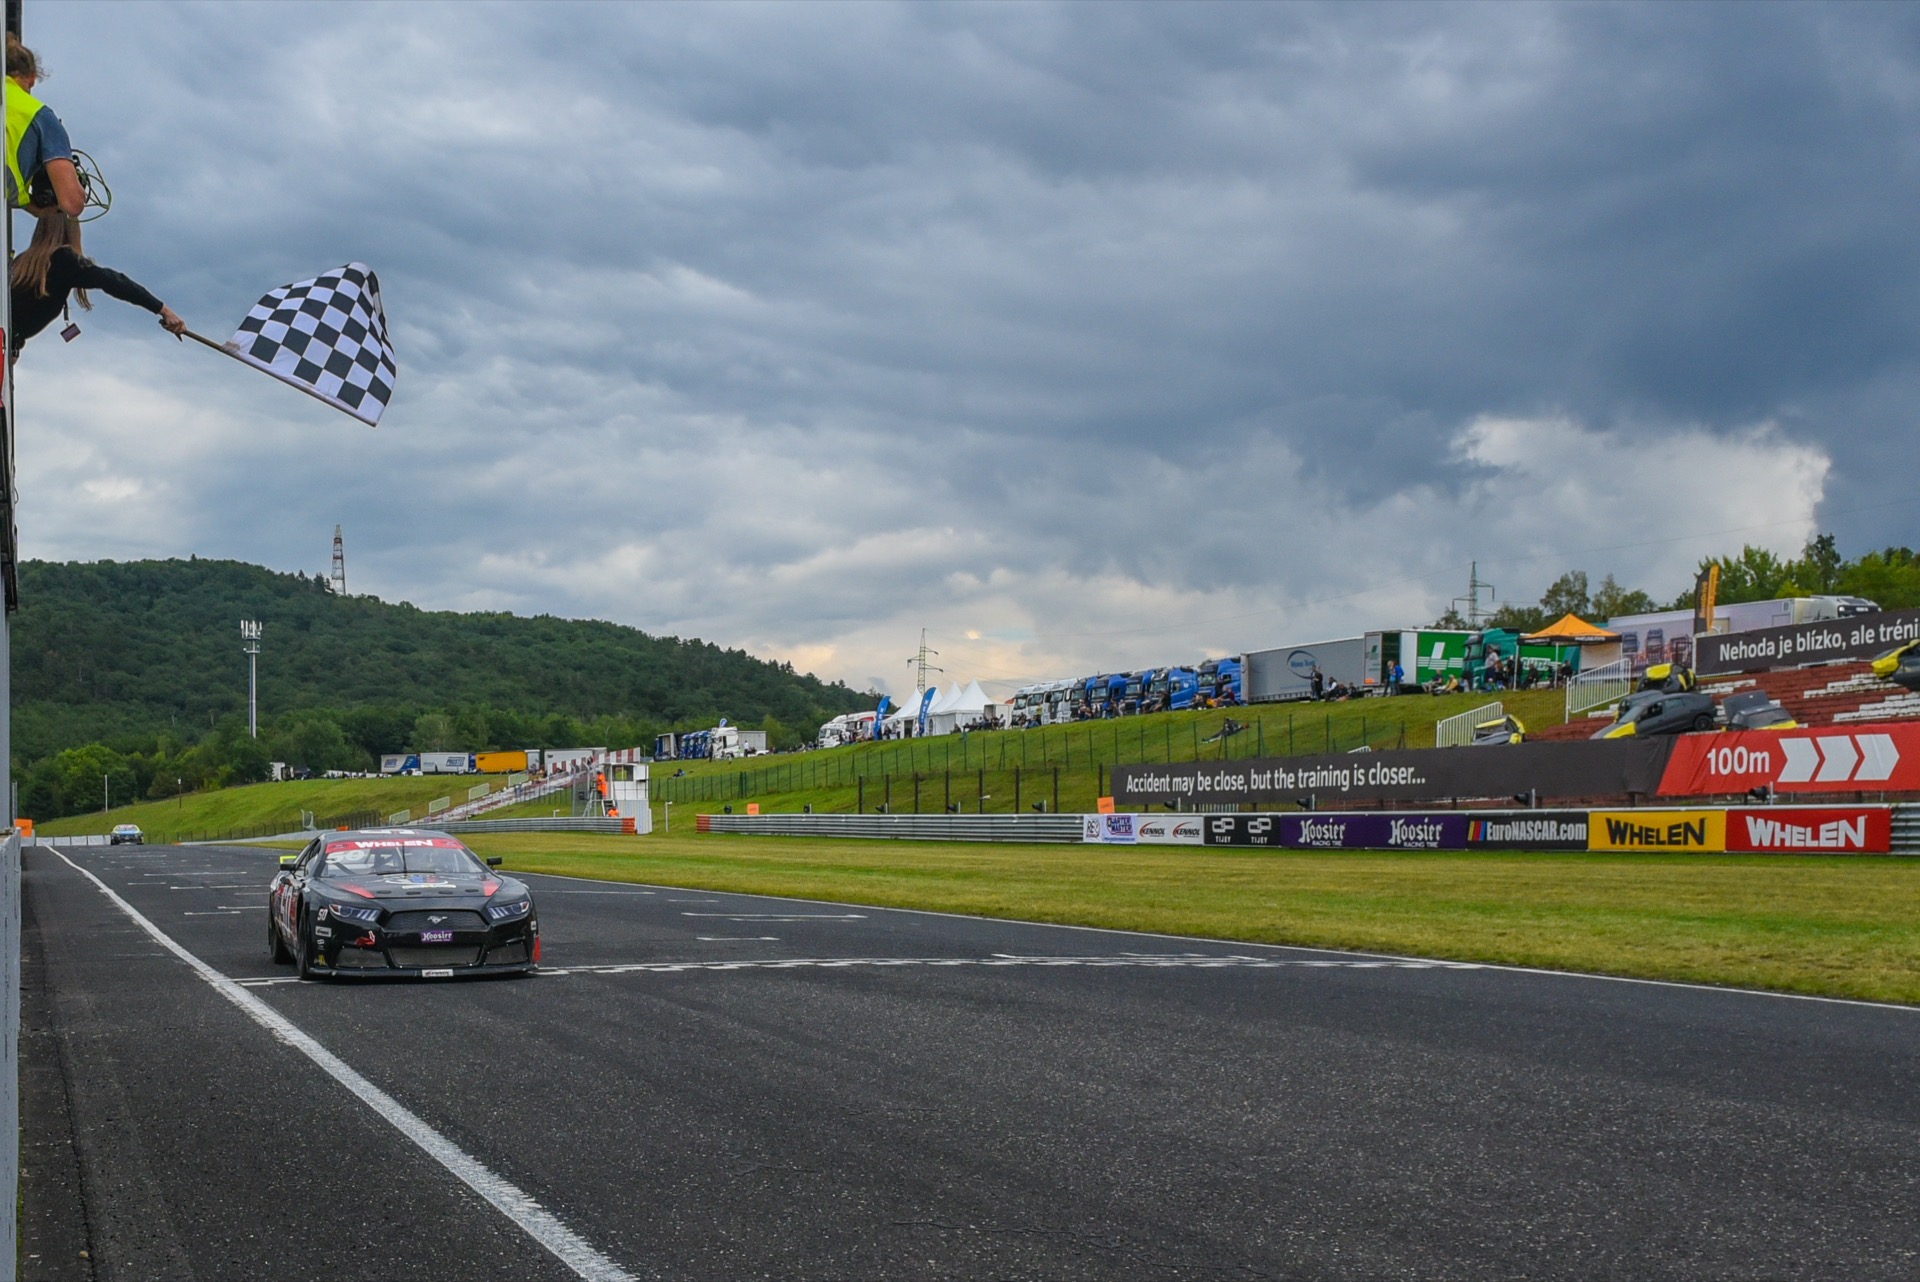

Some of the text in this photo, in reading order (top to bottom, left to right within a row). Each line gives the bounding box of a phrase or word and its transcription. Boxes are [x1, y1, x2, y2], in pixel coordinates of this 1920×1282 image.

[1720, 617, 1920, 662] Nehoda je blízko, ale tréni
[1707, 746, 1769, 775] 100m
[1126, 761, 1426, 796] Accident may be close, but the training is closer...
[354, 839, 434, 849] WHELEN
[1298, 817, 1346, 844] Hoosier
[1388, 817, 1444, 845] Hoosier
[1486, 820, 1587, 841] EuroNASCAR.com
[1605, 817, 1707, 846] WHELEN
[1745, 815, 1867, 848] WHELEN
